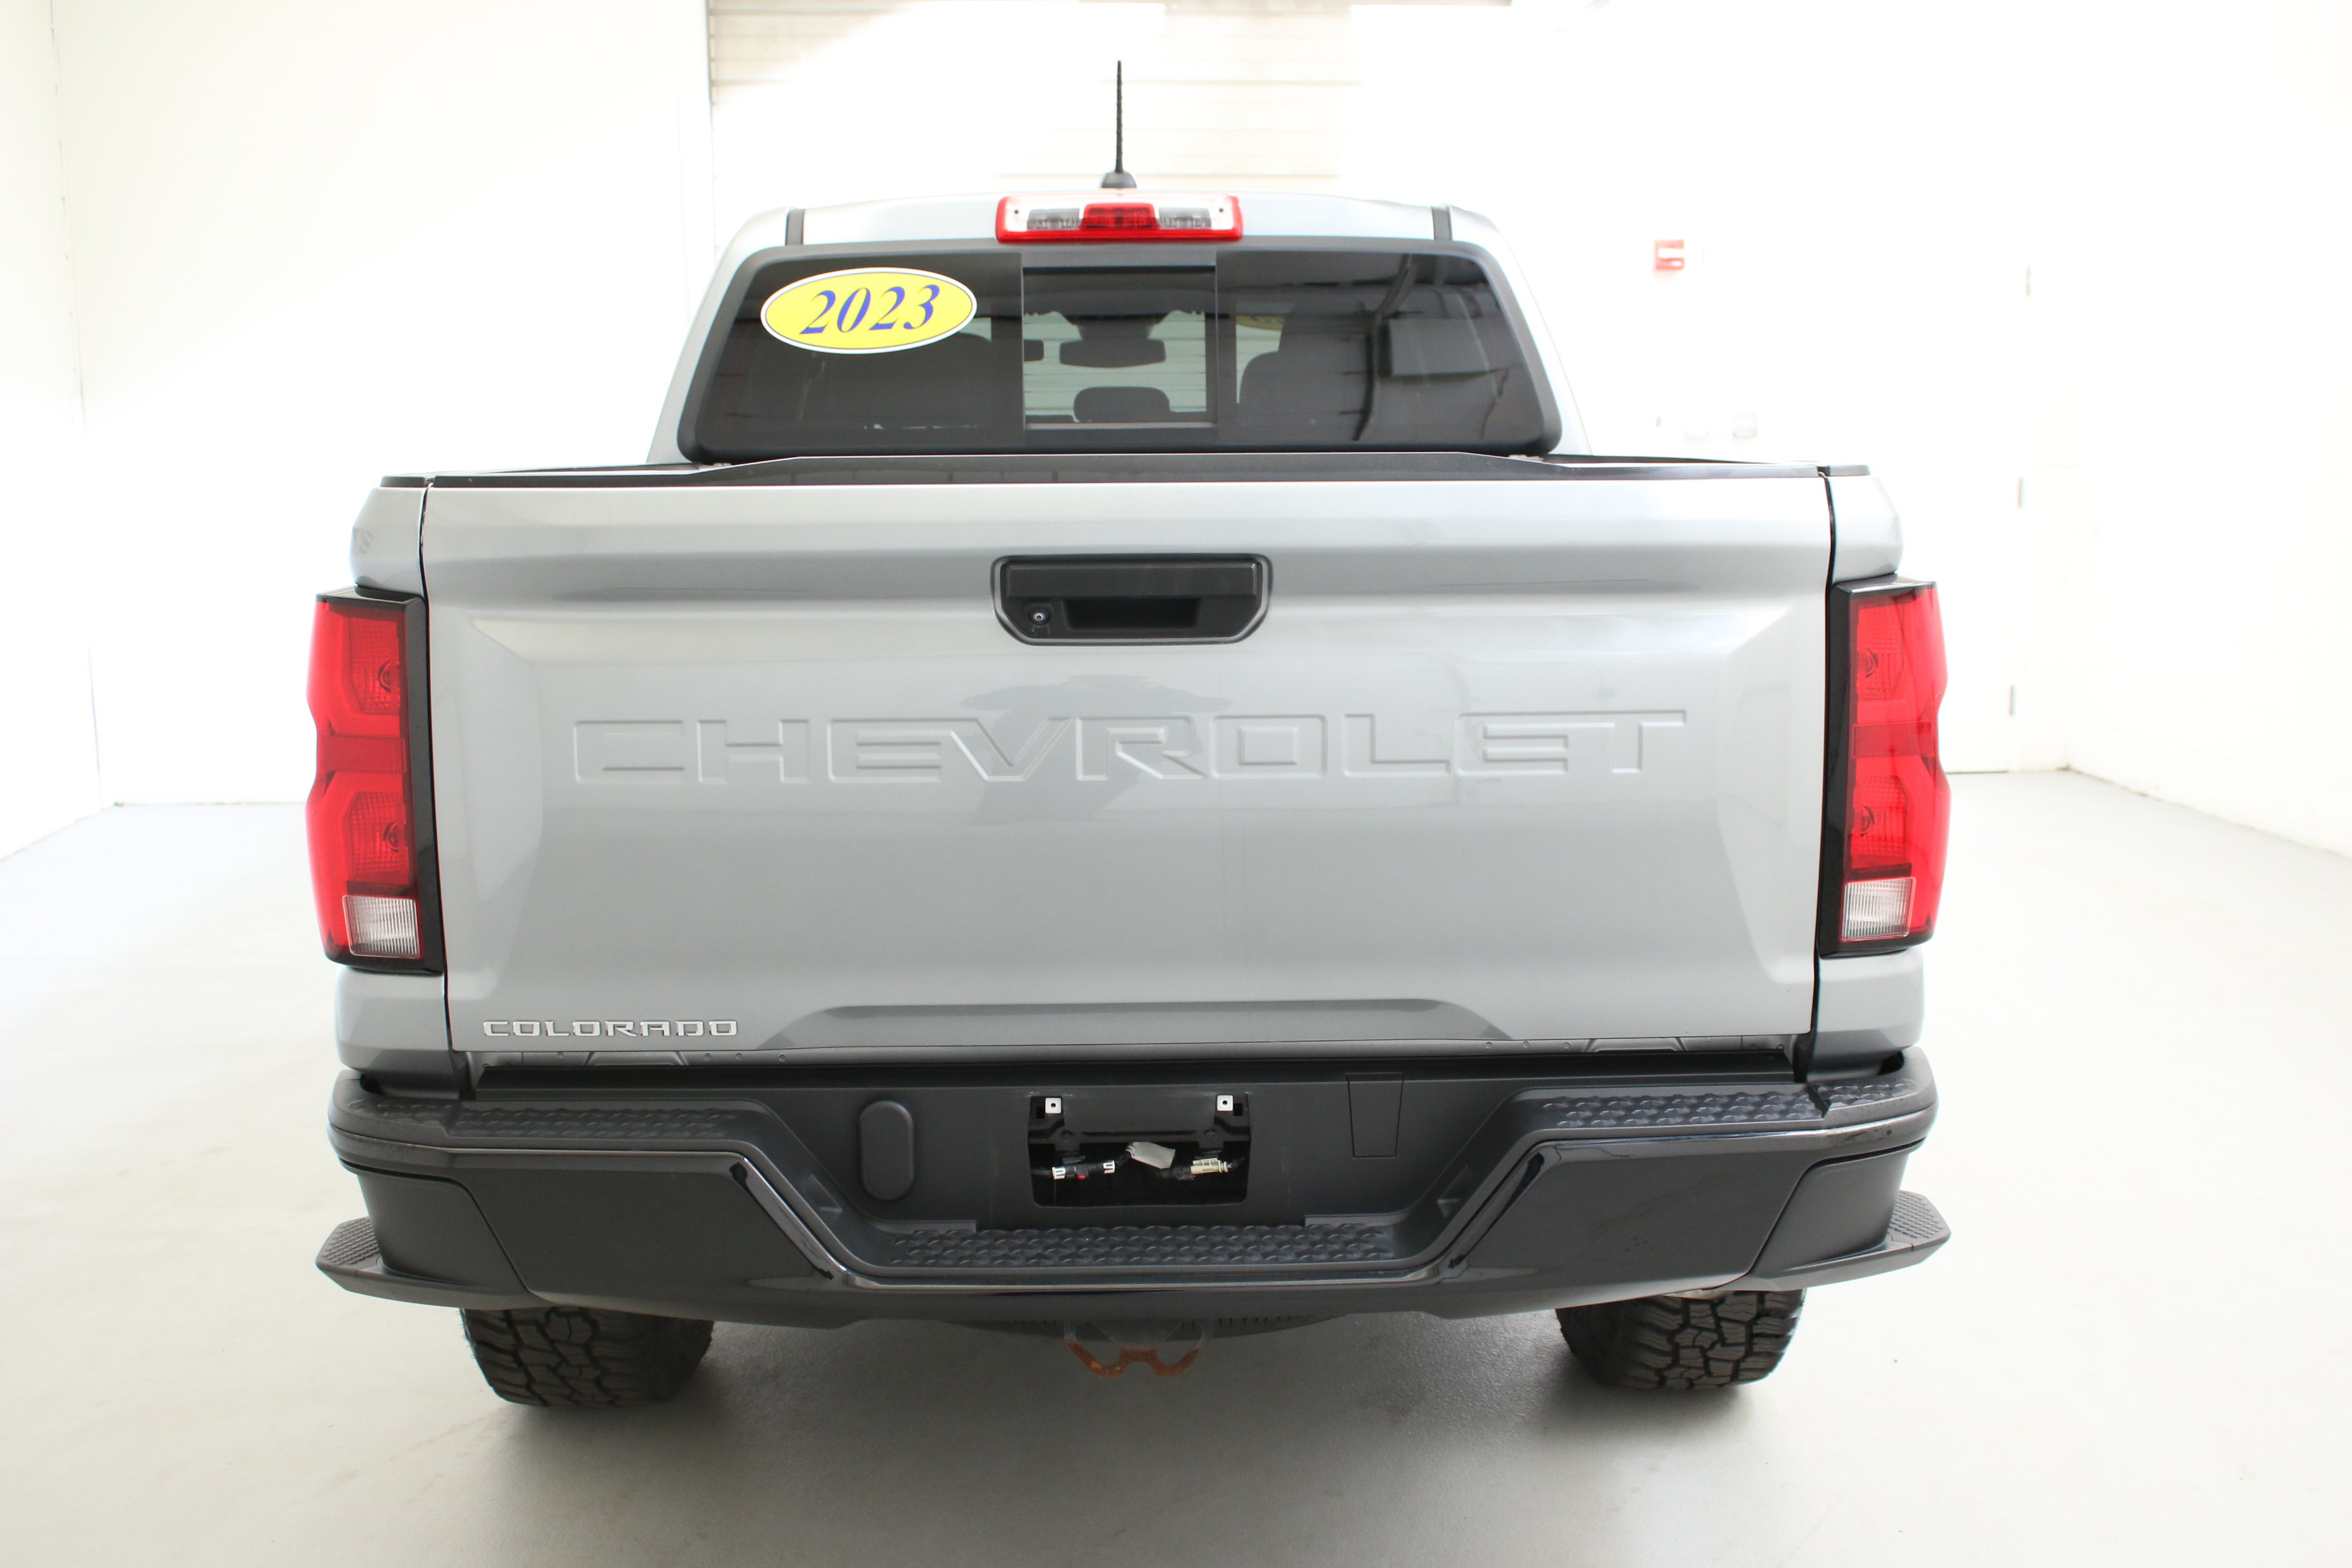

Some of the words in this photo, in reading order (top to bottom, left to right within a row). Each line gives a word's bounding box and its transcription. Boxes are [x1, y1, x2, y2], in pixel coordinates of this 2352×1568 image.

[799, 284, 941, 335] 2023
[573, 709, 1687, 784] CHEVROLET
[482, 1019, 739, 1037] COLORADO
